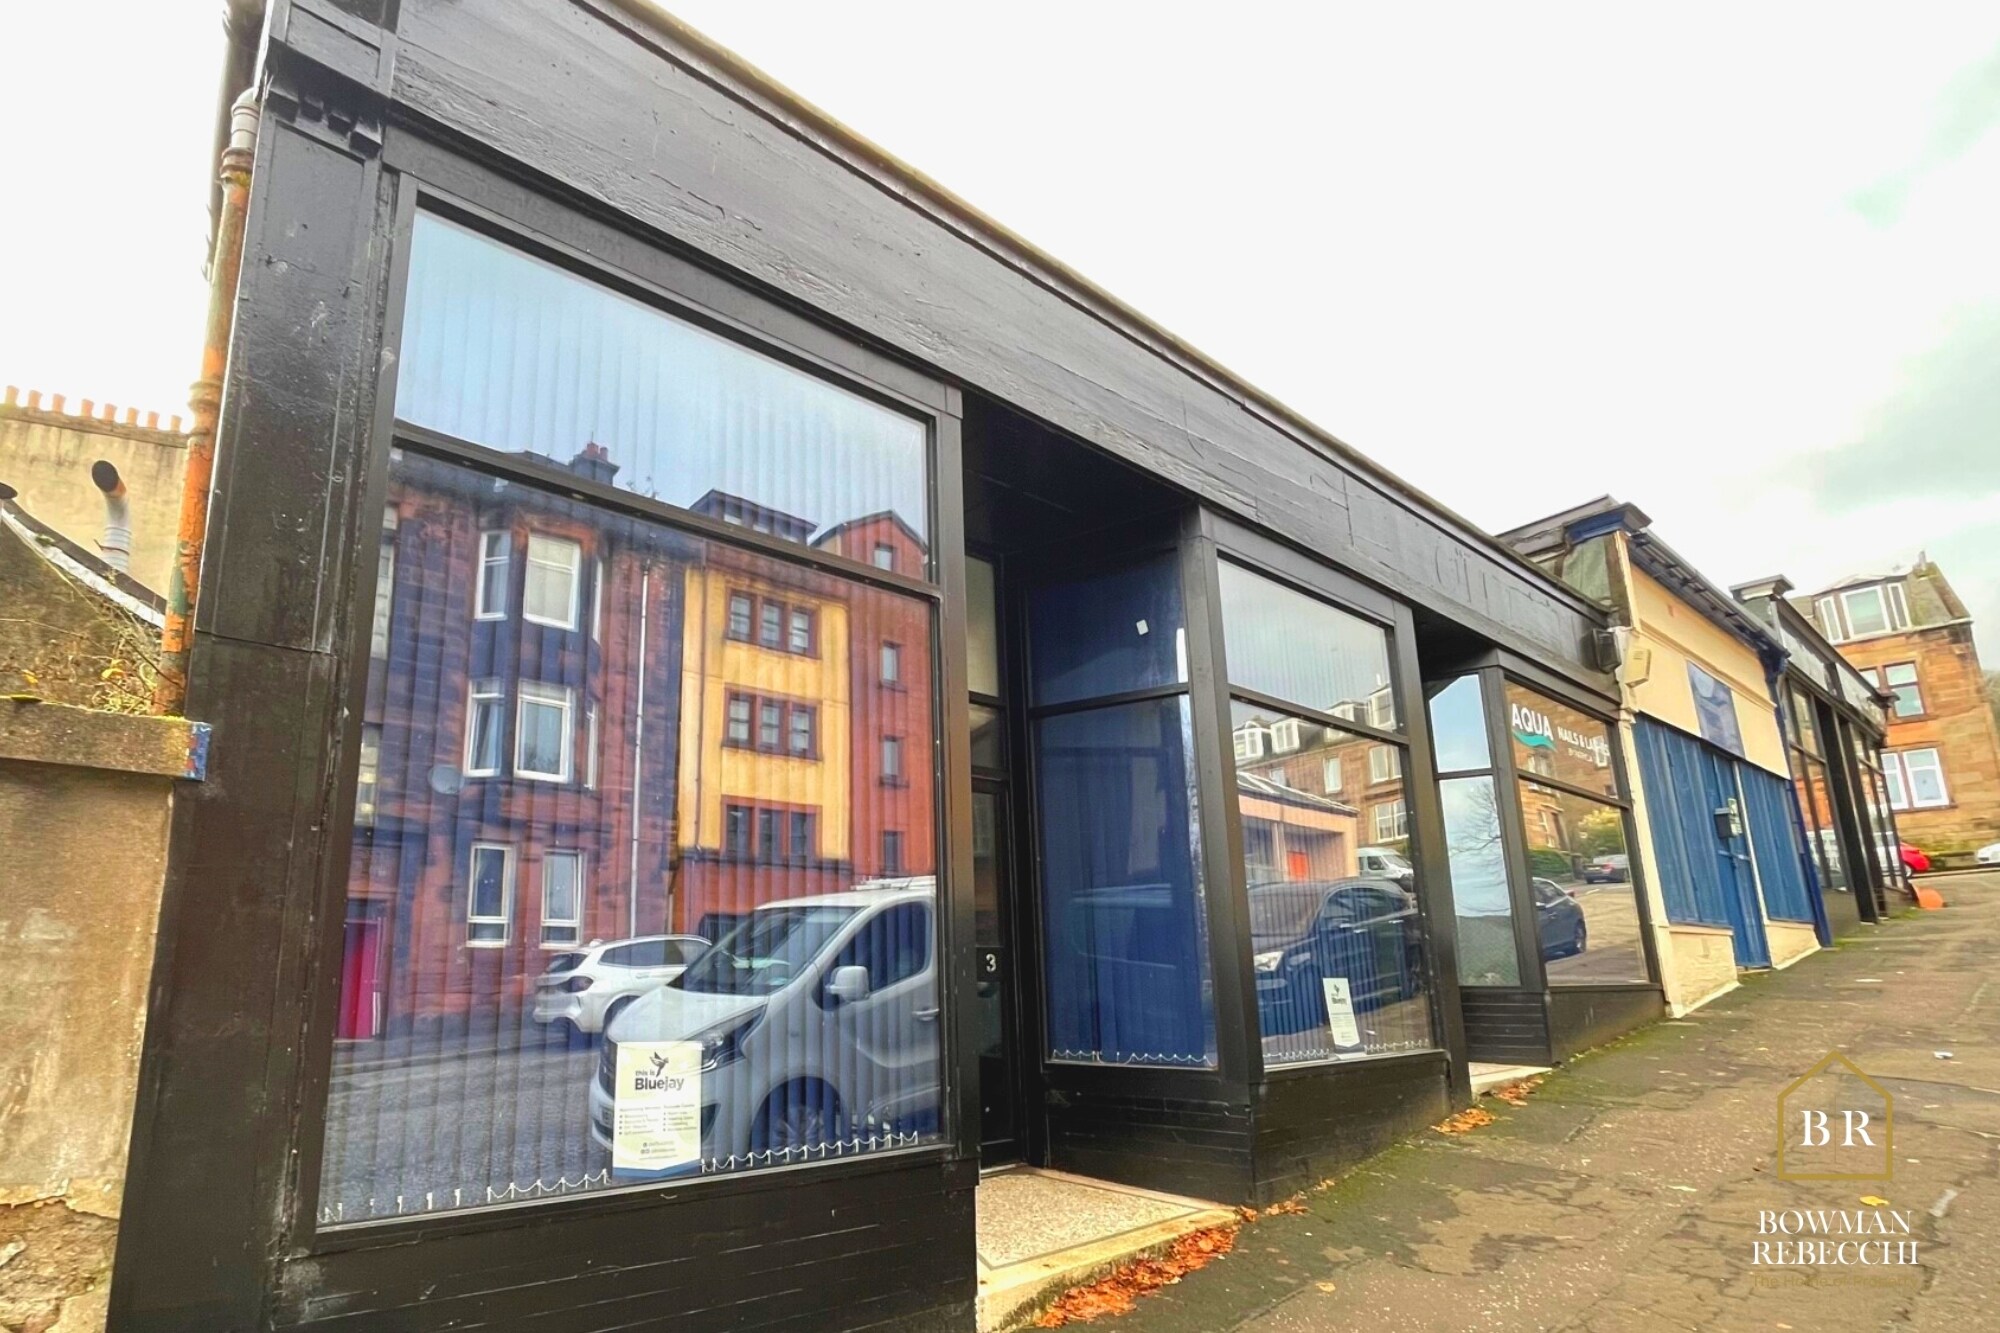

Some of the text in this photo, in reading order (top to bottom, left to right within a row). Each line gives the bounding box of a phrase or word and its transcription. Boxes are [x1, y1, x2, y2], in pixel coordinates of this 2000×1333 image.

[1512, 703, 1554, 741] AQUA
[1557, 726, 1579, 745] NAILS
[986, 953, 997, 972] 3
[635, 1076, 685, 1092] Bluejay
